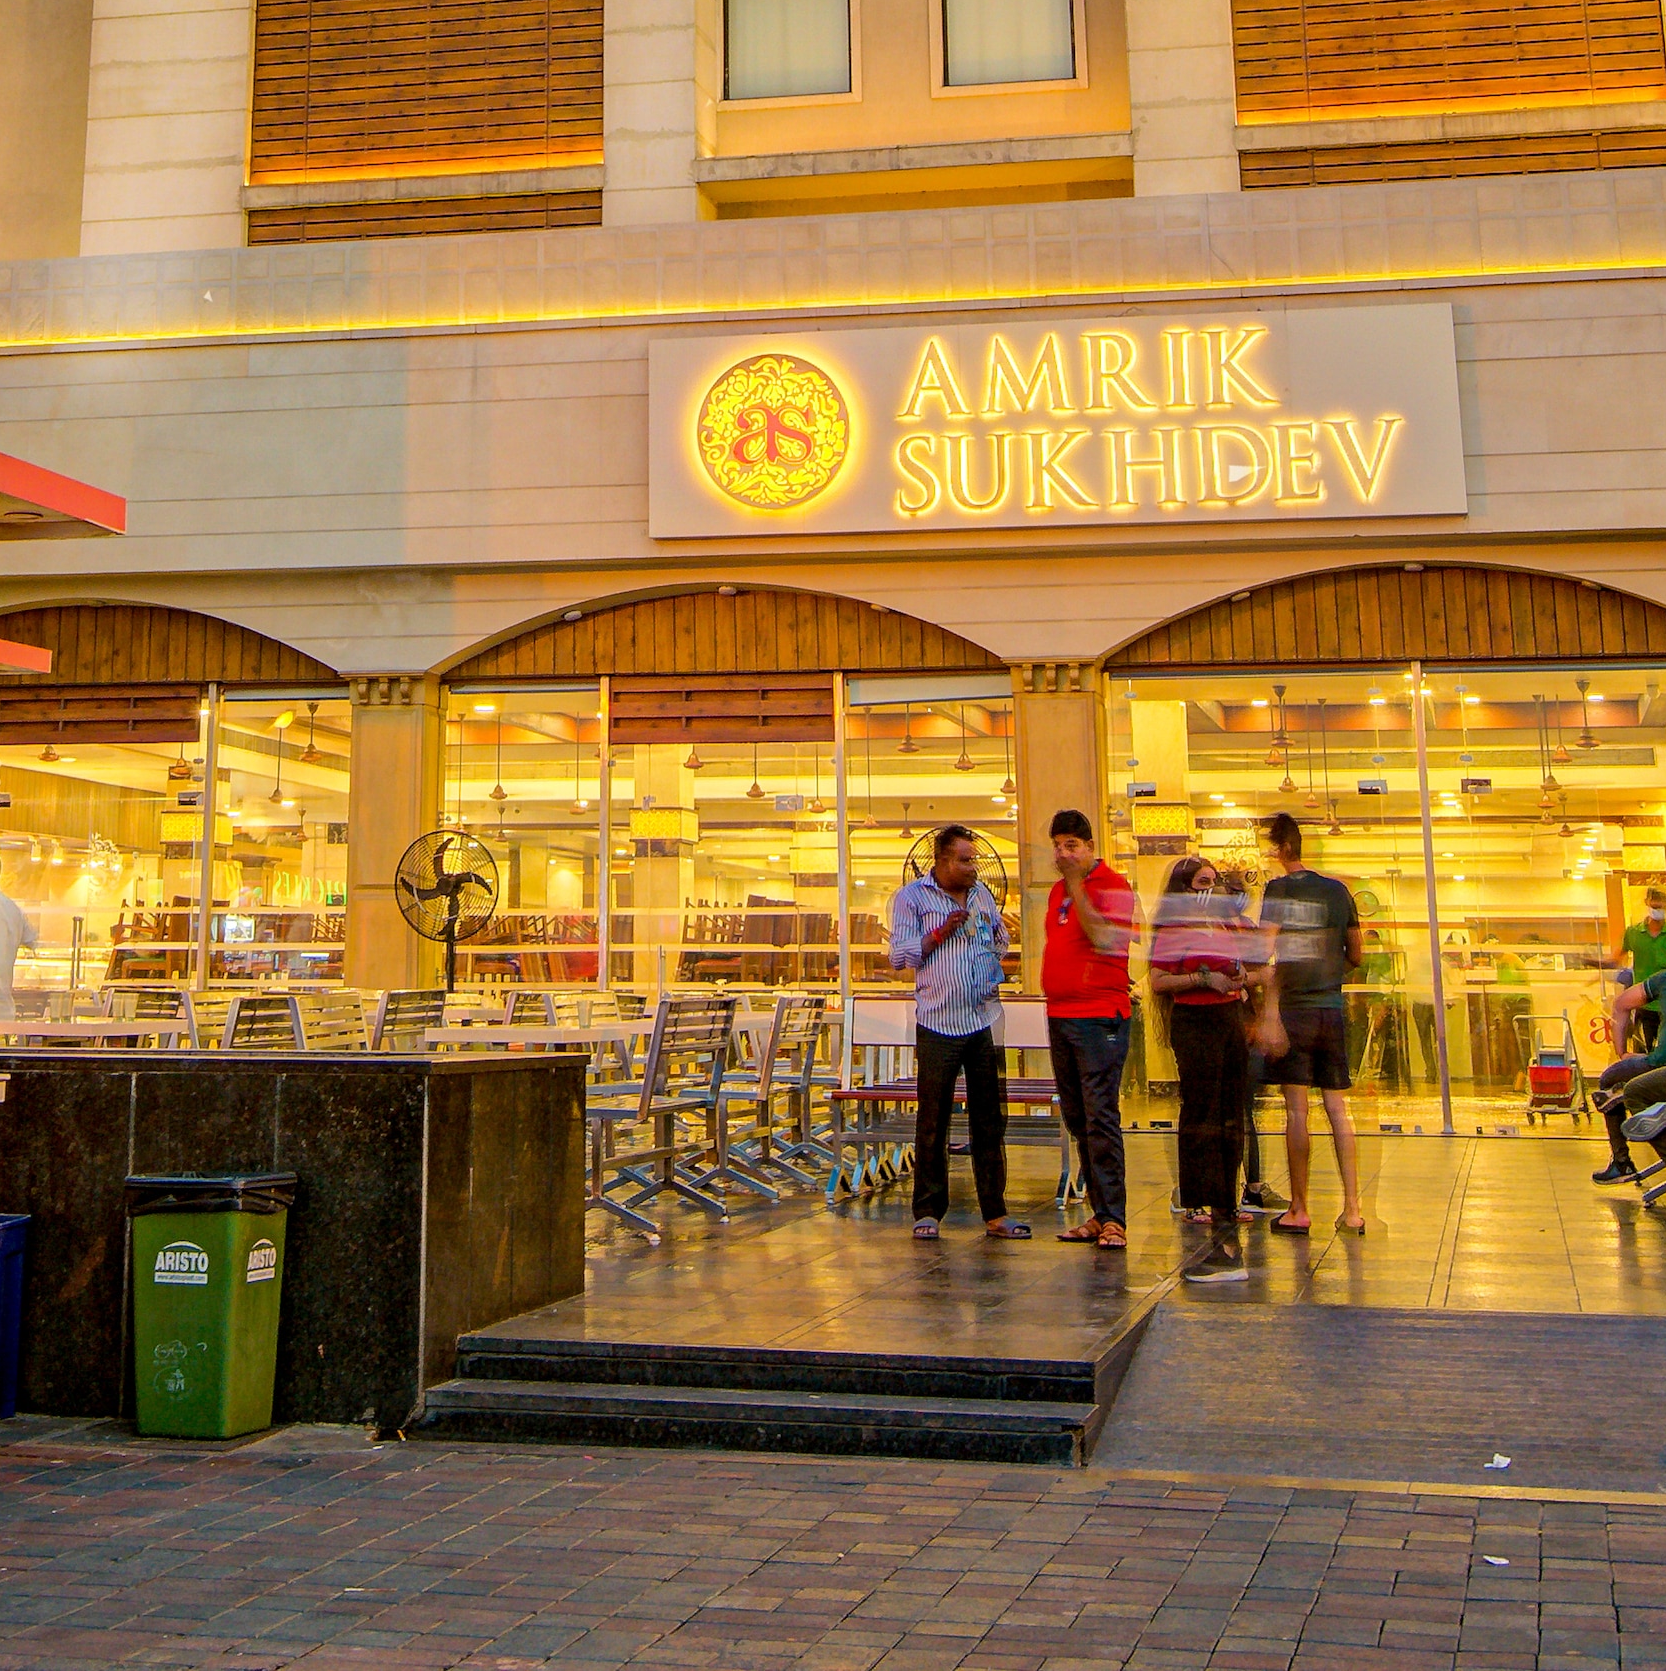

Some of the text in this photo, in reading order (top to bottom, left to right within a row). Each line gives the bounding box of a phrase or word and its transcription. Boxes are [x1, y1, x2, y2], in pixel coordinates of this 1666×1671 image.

[897, 326, 1281, 420] AMRIK
[897, 417, 1403, 518] SUKHDEV
[155, 1251, 209, 1272] ARISTO
[247, 1247, 277, 1270] ARISTO
